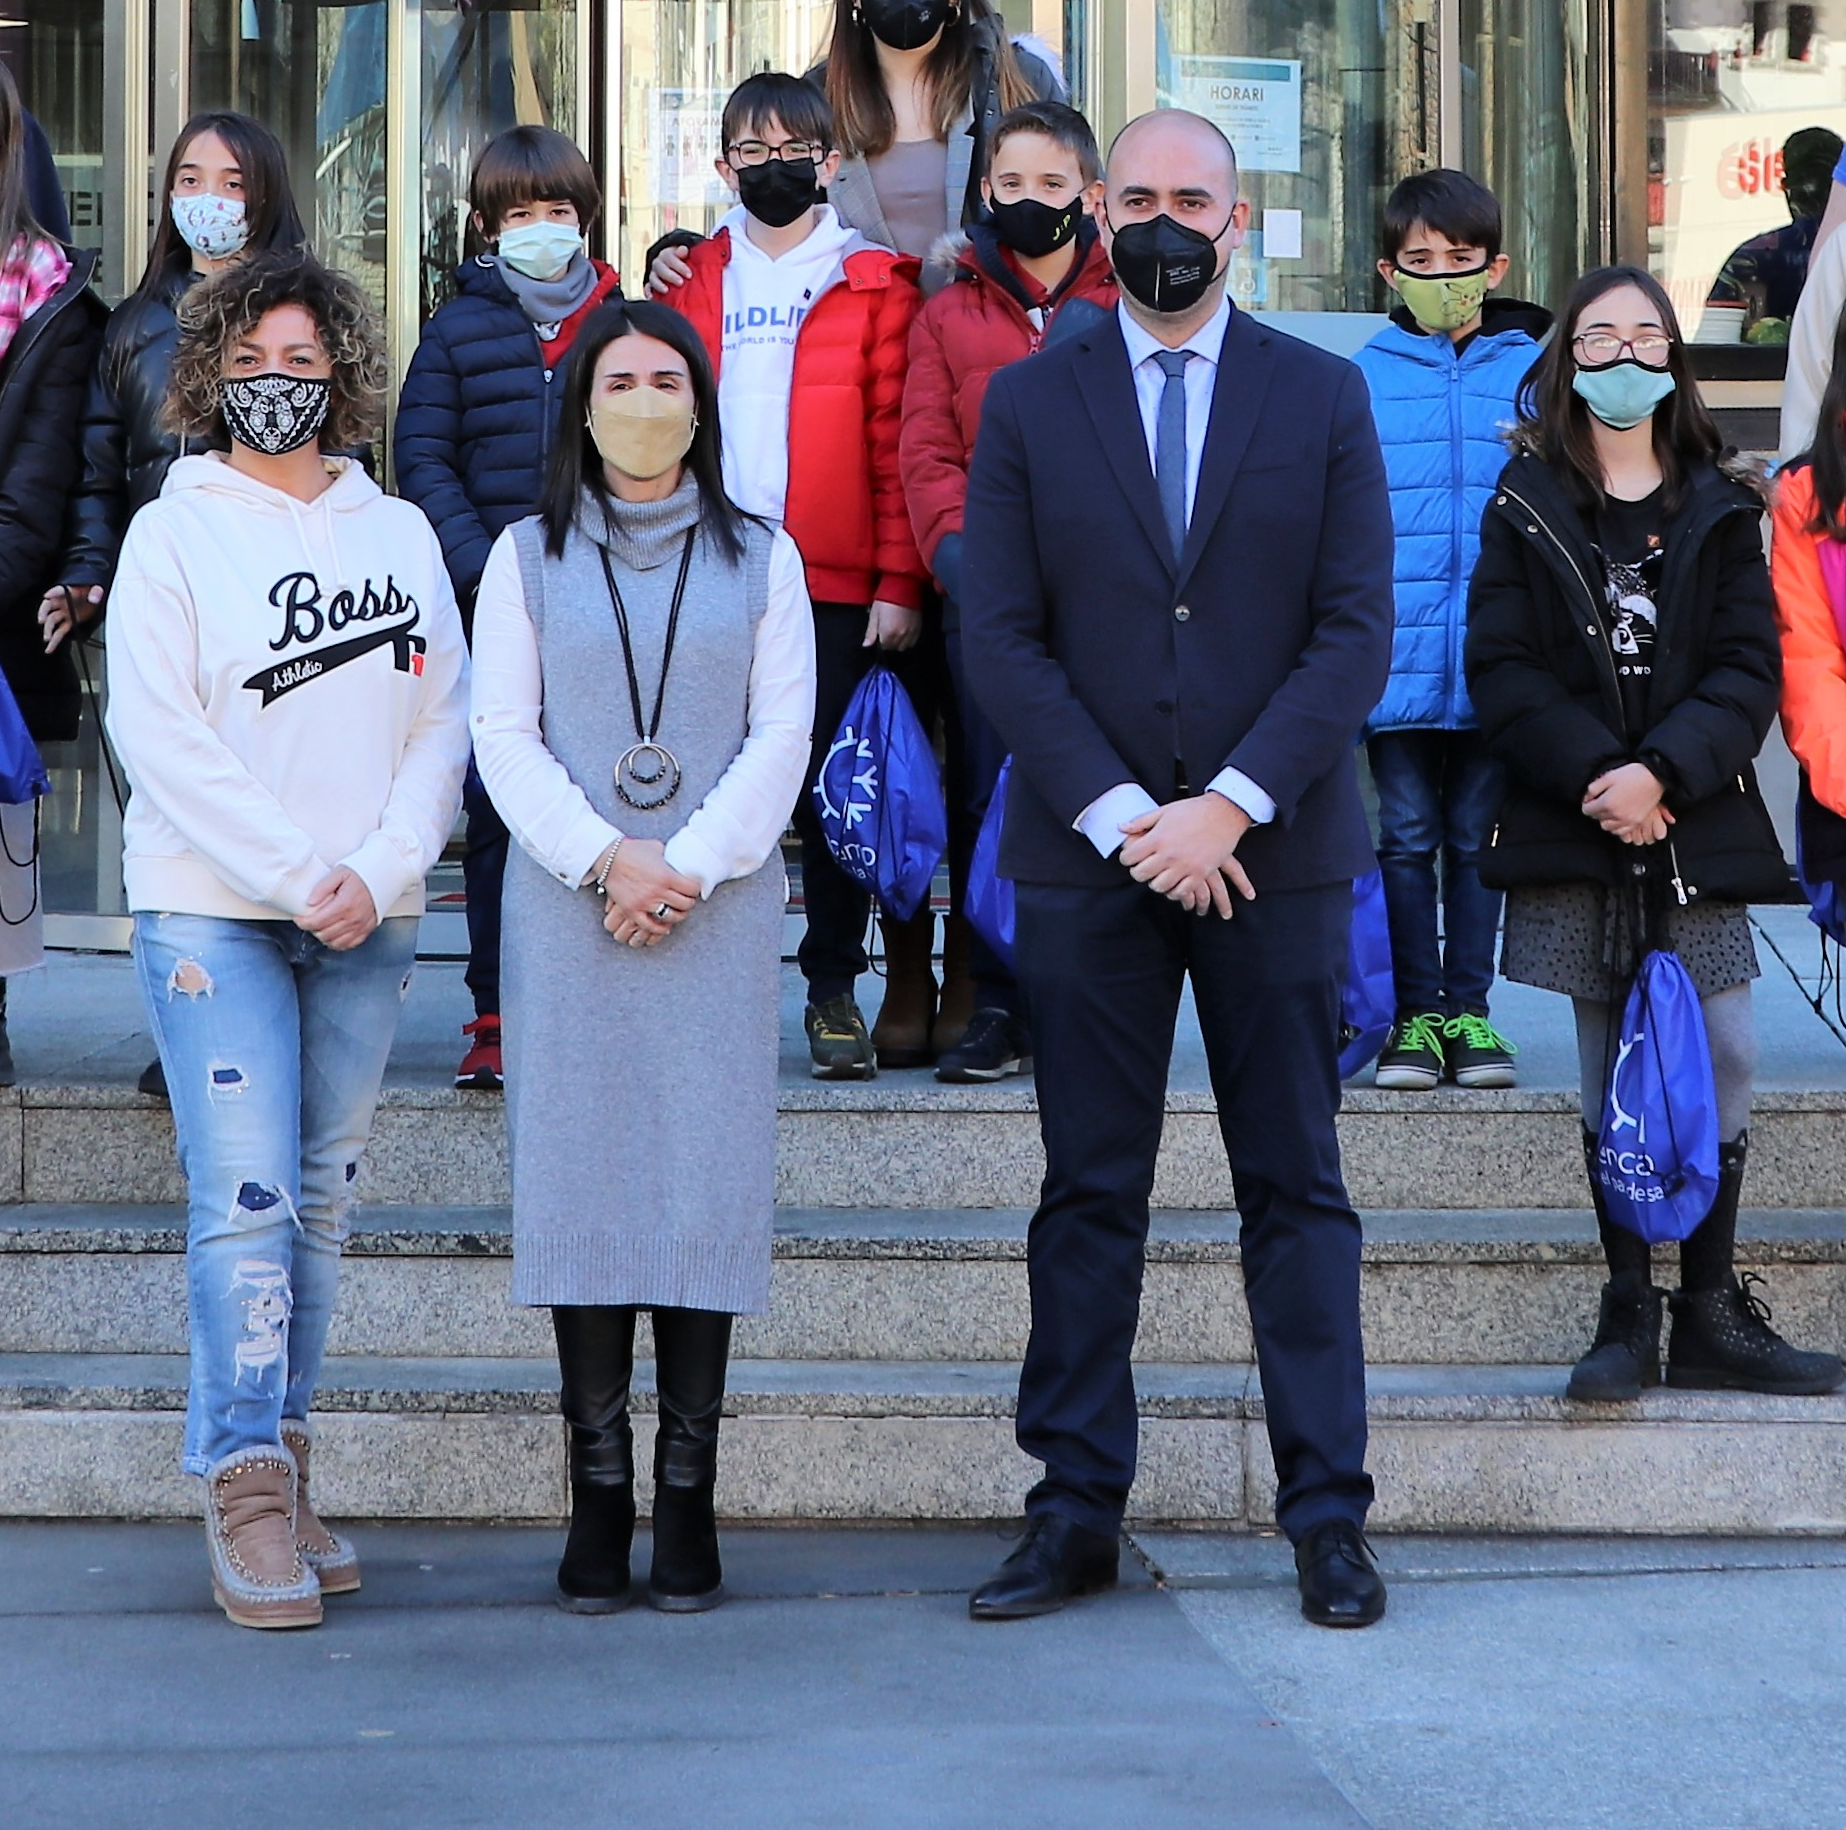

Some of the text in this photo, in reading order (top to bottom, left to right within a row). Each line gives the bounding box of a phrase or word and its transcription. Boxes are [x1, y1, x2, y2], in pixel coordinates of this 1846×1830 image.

[1210, 85, 1264, 102] HORARI
[780, 336, 795, 345] YOU
[269, 571, 415, 651] Boss
[272, 660, 323, 692] Athletic
[1633, 665, 1651, 675] WO
